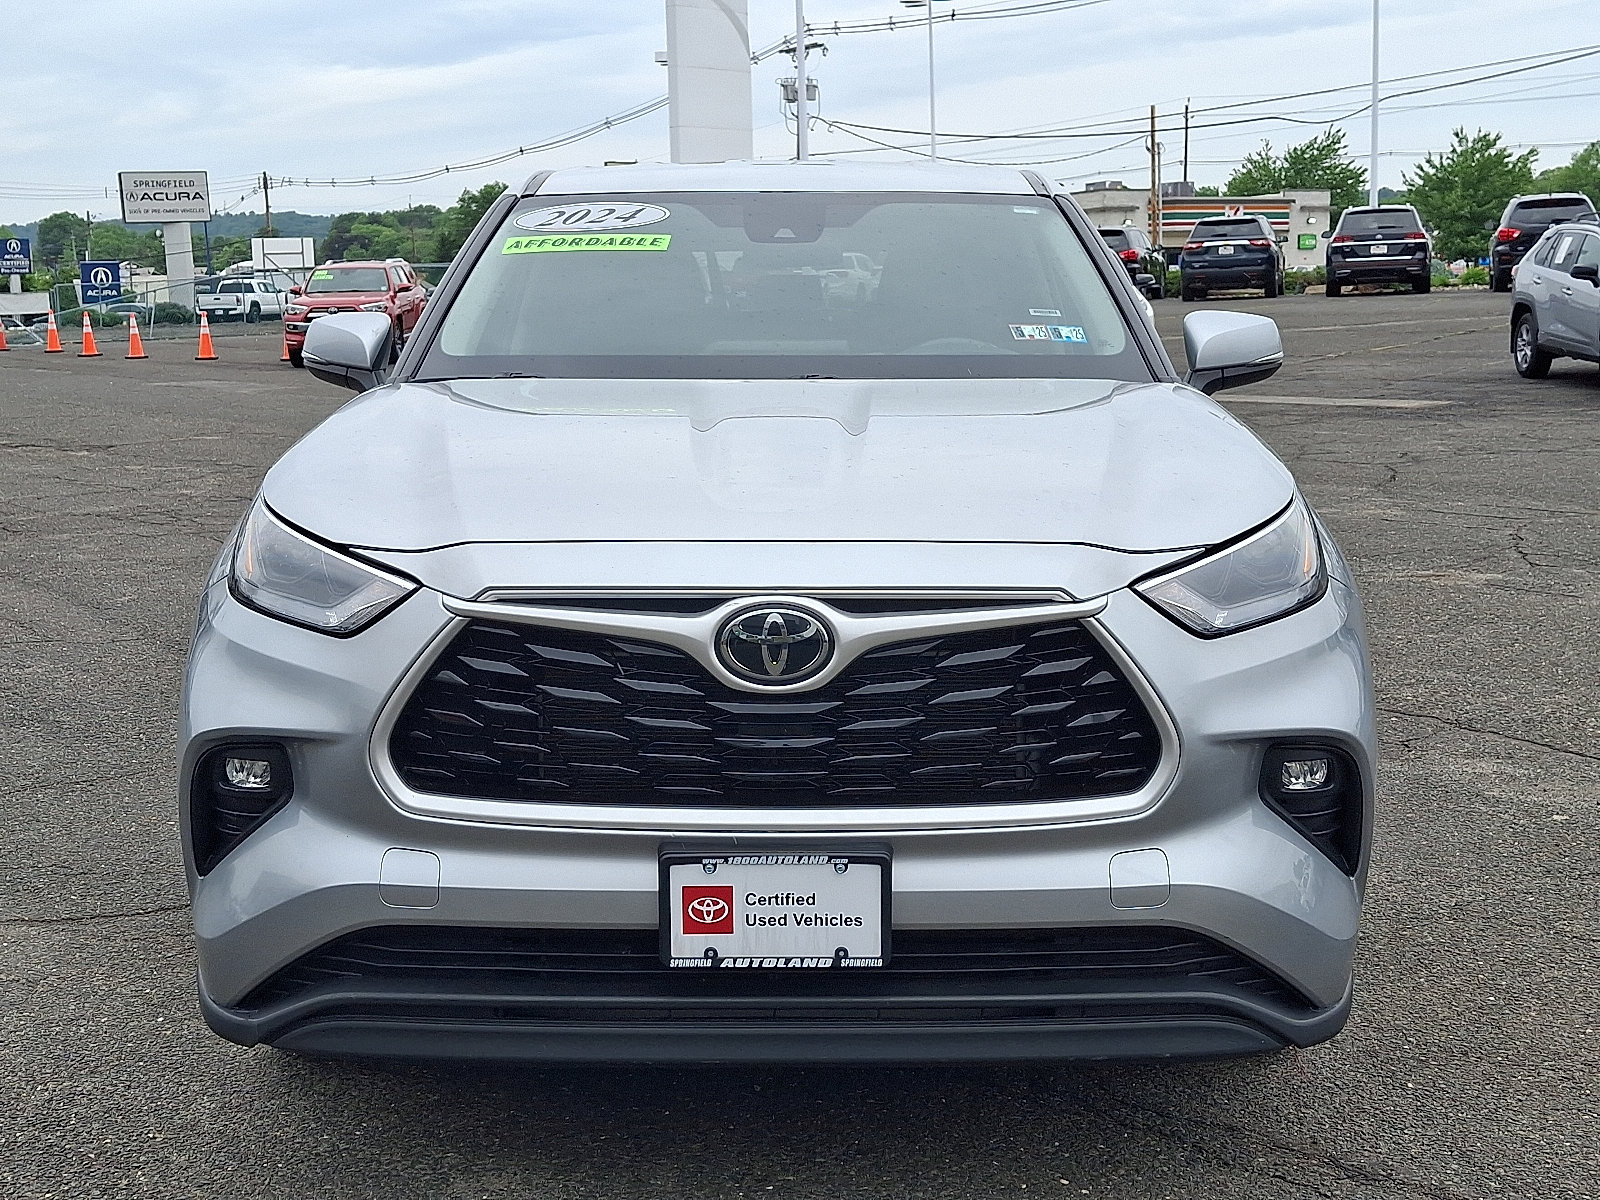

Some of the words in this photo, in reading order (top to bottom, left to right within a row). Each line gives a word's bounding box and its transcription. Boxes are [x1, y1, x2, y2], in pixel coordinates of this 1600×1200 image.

[133, 179, 195, 188] SPRINGFIELD
[140, 191, 205, 202] ACURA
[533, 207, 646, 228] 2024
[506, 237, 665, 250] AFFORDABLE
[702, 856, 849, 865] www.1800AUTOLAND.com
[745, 892, 816, 906] Certified
[745, 913, 788, 927] Used
[792, 912, 863, 927] Vehicles
[670, 958, 712, 968] SPRINGFIELD
[720, 957, 833, 968] AUTOLAND
[840, 958, 883, 968] SPRINGFIELD
